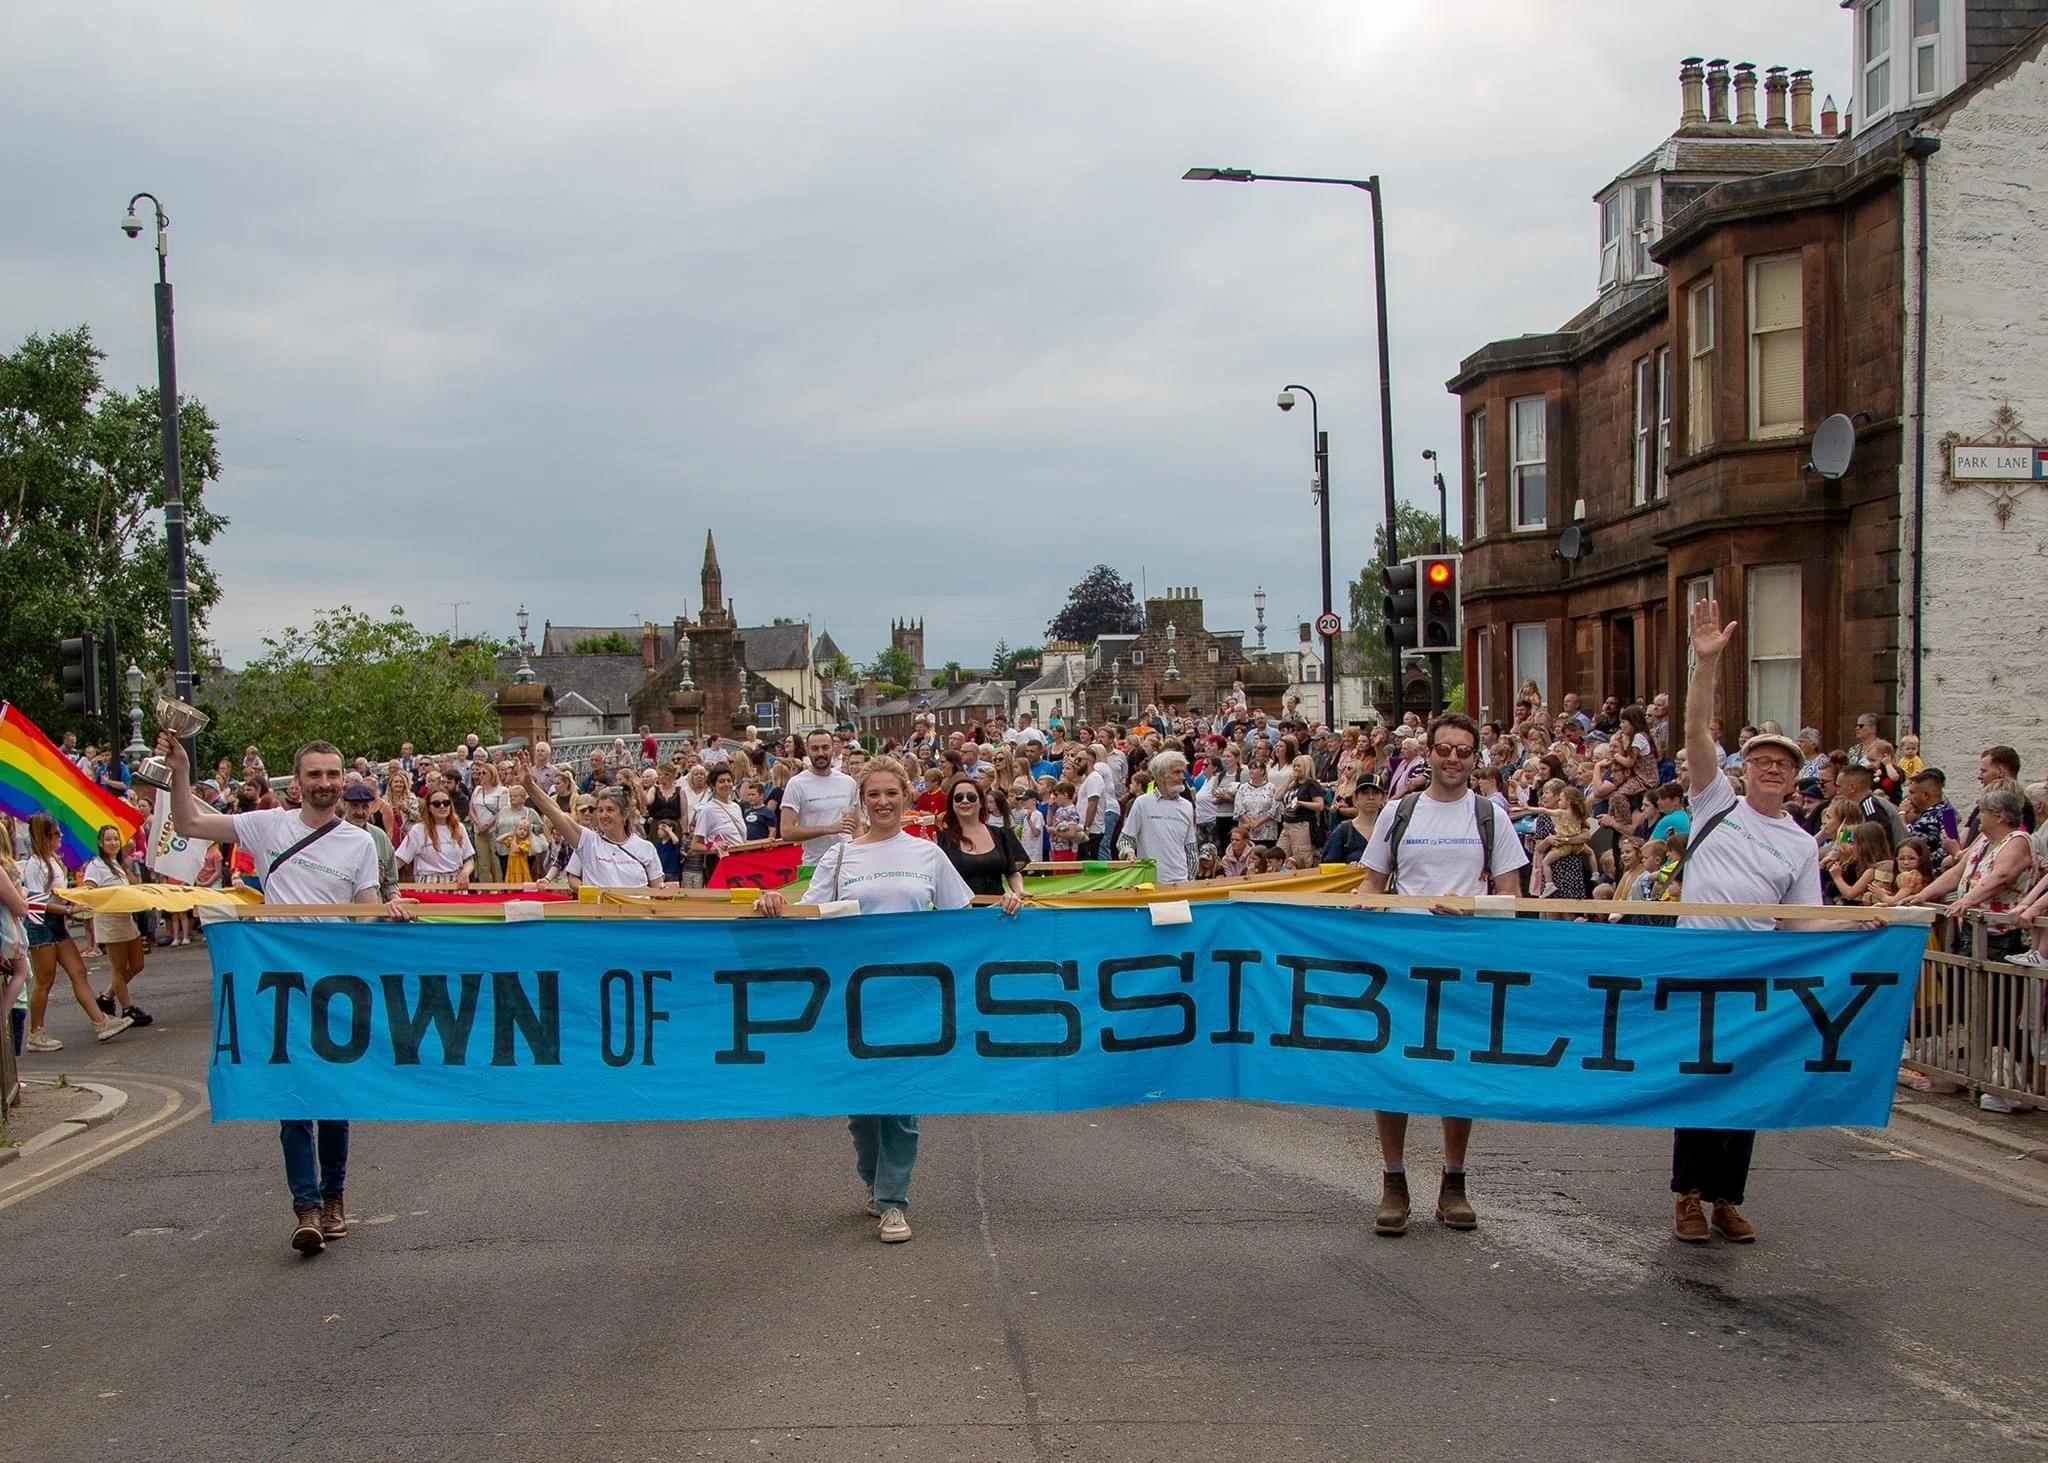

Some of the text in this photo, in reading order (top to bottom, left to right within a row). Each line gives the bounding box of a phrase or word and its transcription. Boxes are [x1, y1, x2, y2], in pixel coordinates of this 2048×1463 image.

[1957, 456, 2028, 468] PARK LANE
[1321, 619, 1337, 629] 20
[873, 870, 934, 882] POSSIBILITY
[213, 948, 1900, 1077] A TOWN OF POSSIBILITY
